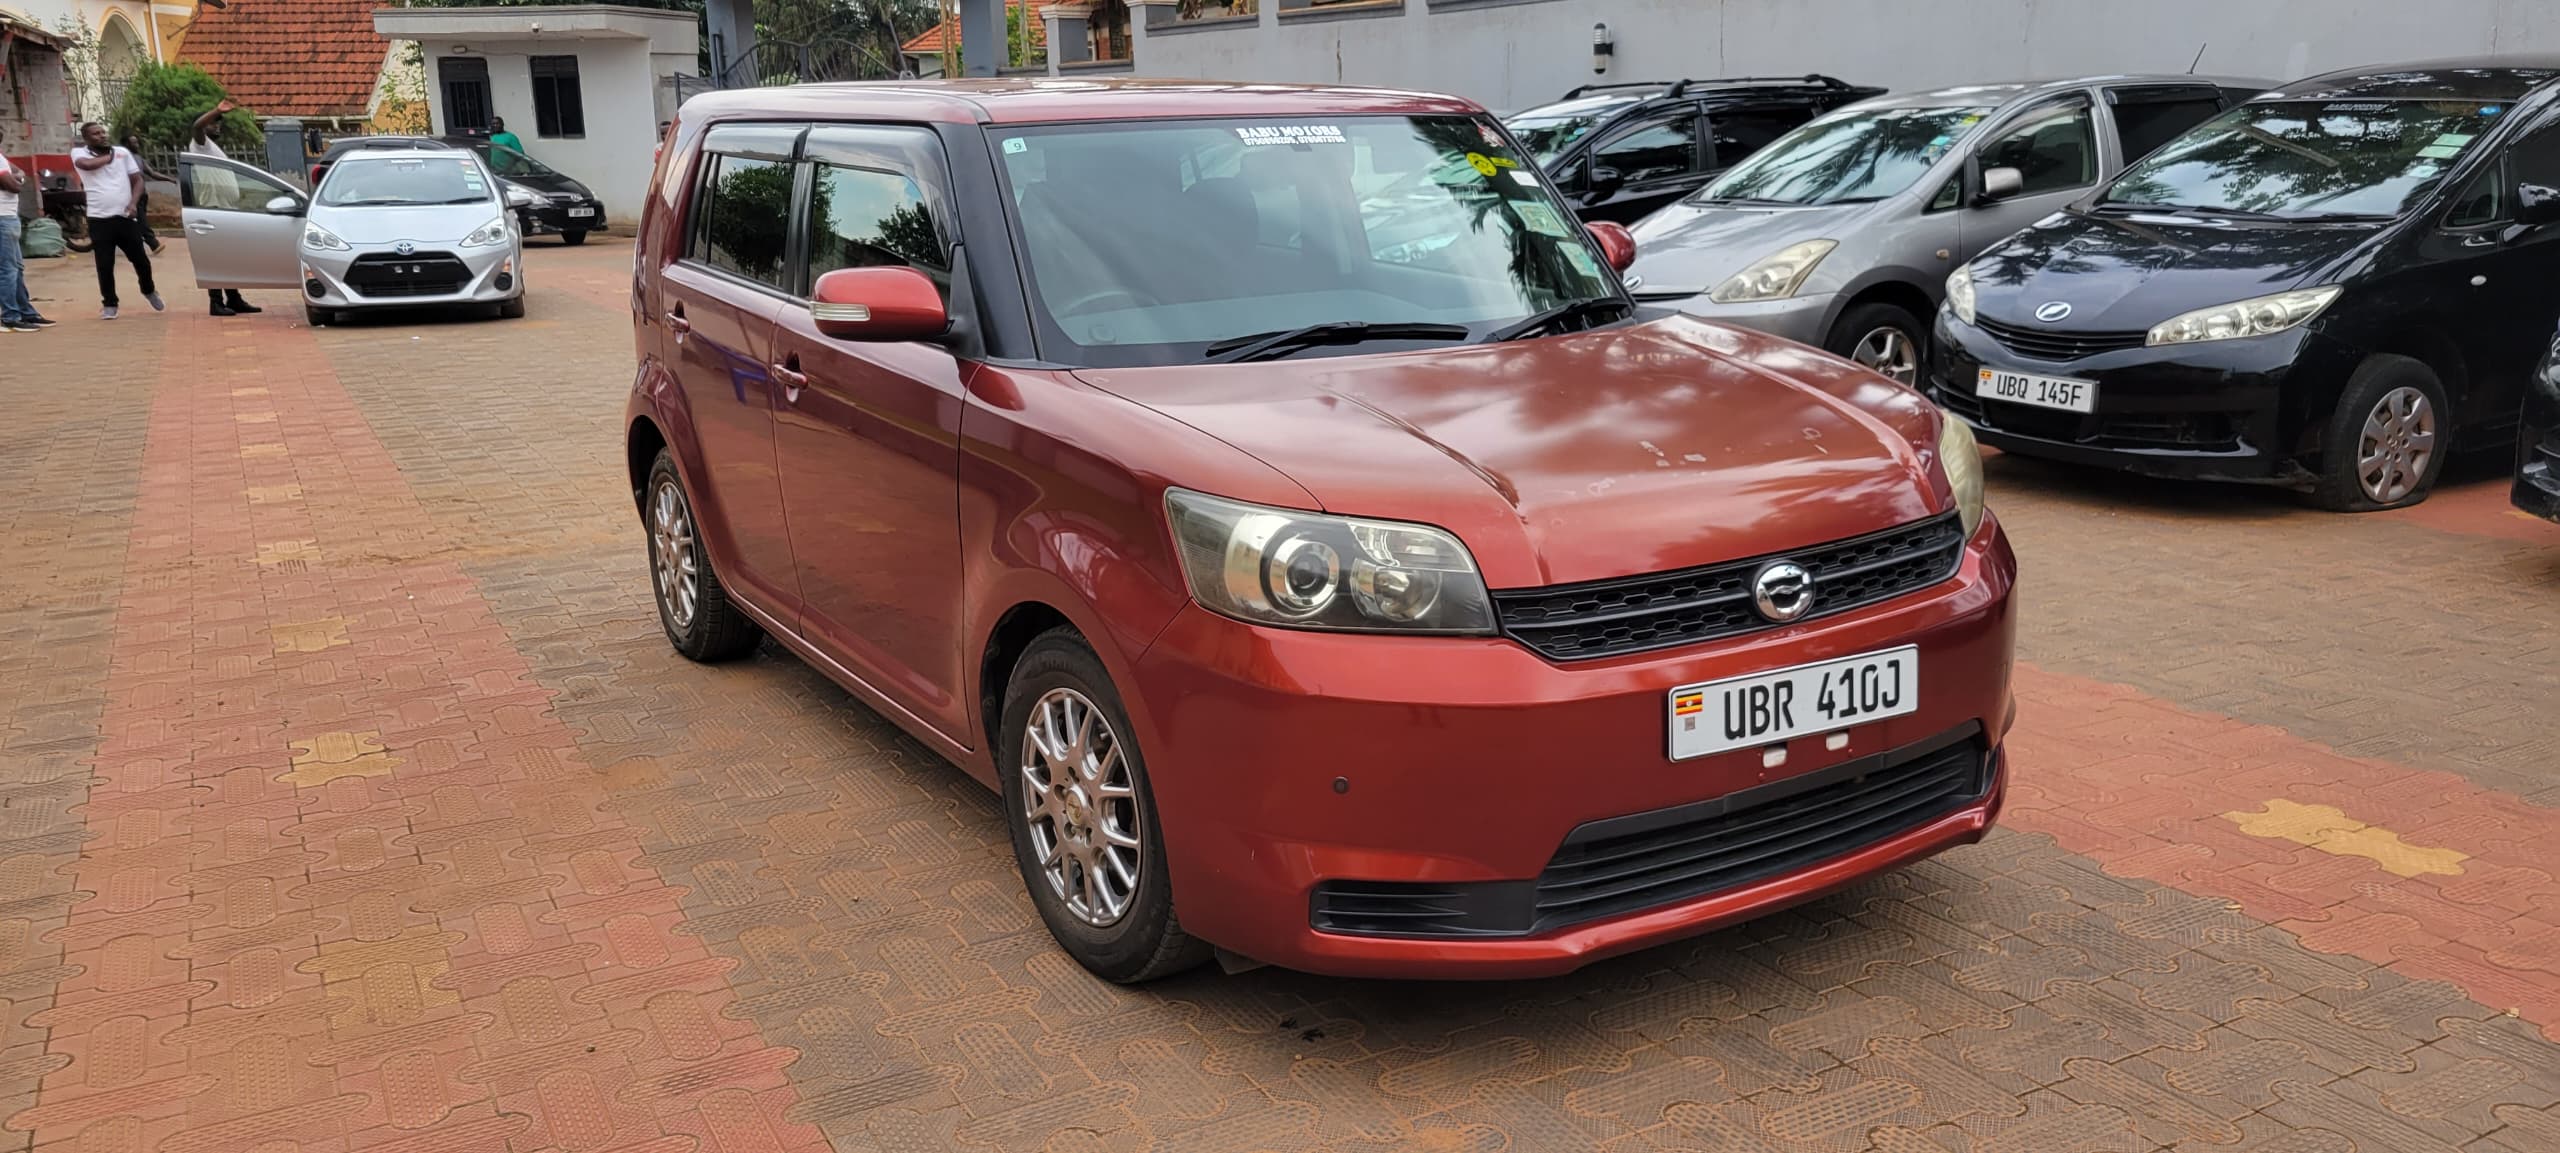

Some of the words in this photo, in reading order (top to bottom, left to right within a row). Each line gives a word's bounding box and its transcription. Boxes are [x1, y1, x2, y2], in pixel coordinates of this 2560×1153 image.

[1236, 127, 1279, 139] BABU
[1996, 374, 2028, 399] UBQ
[2037, 381, 2083, 406] 145F
[1724, 680, 1794, 740] UBR
[1817, 659, 1900, 720] 410J
